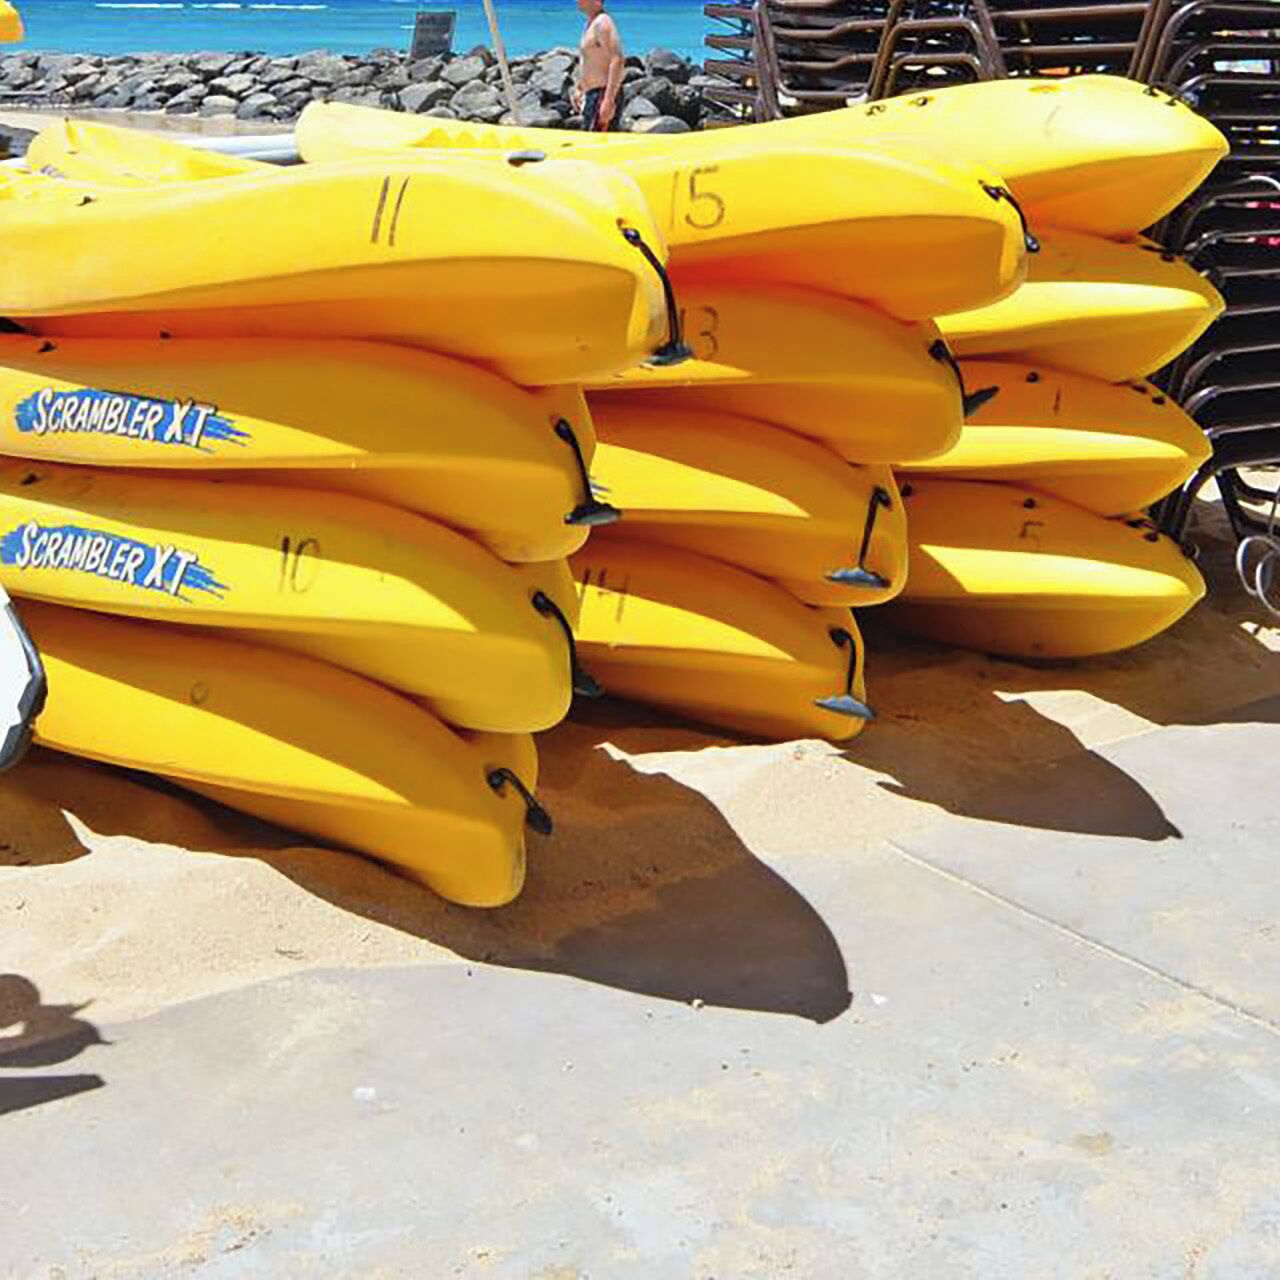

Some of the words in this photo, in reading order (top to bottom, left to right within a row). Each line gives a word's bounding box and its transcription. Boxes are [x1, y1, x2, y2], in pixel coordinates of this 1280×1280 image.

[671, 166, 725, 230] 15
[32, 387, 166, 442] SCRAMBLER
[164, 396, 219, 450] XT
[15, 520, 146, 586] SCRAMBLER
[143, 544, 199, 597] XT
